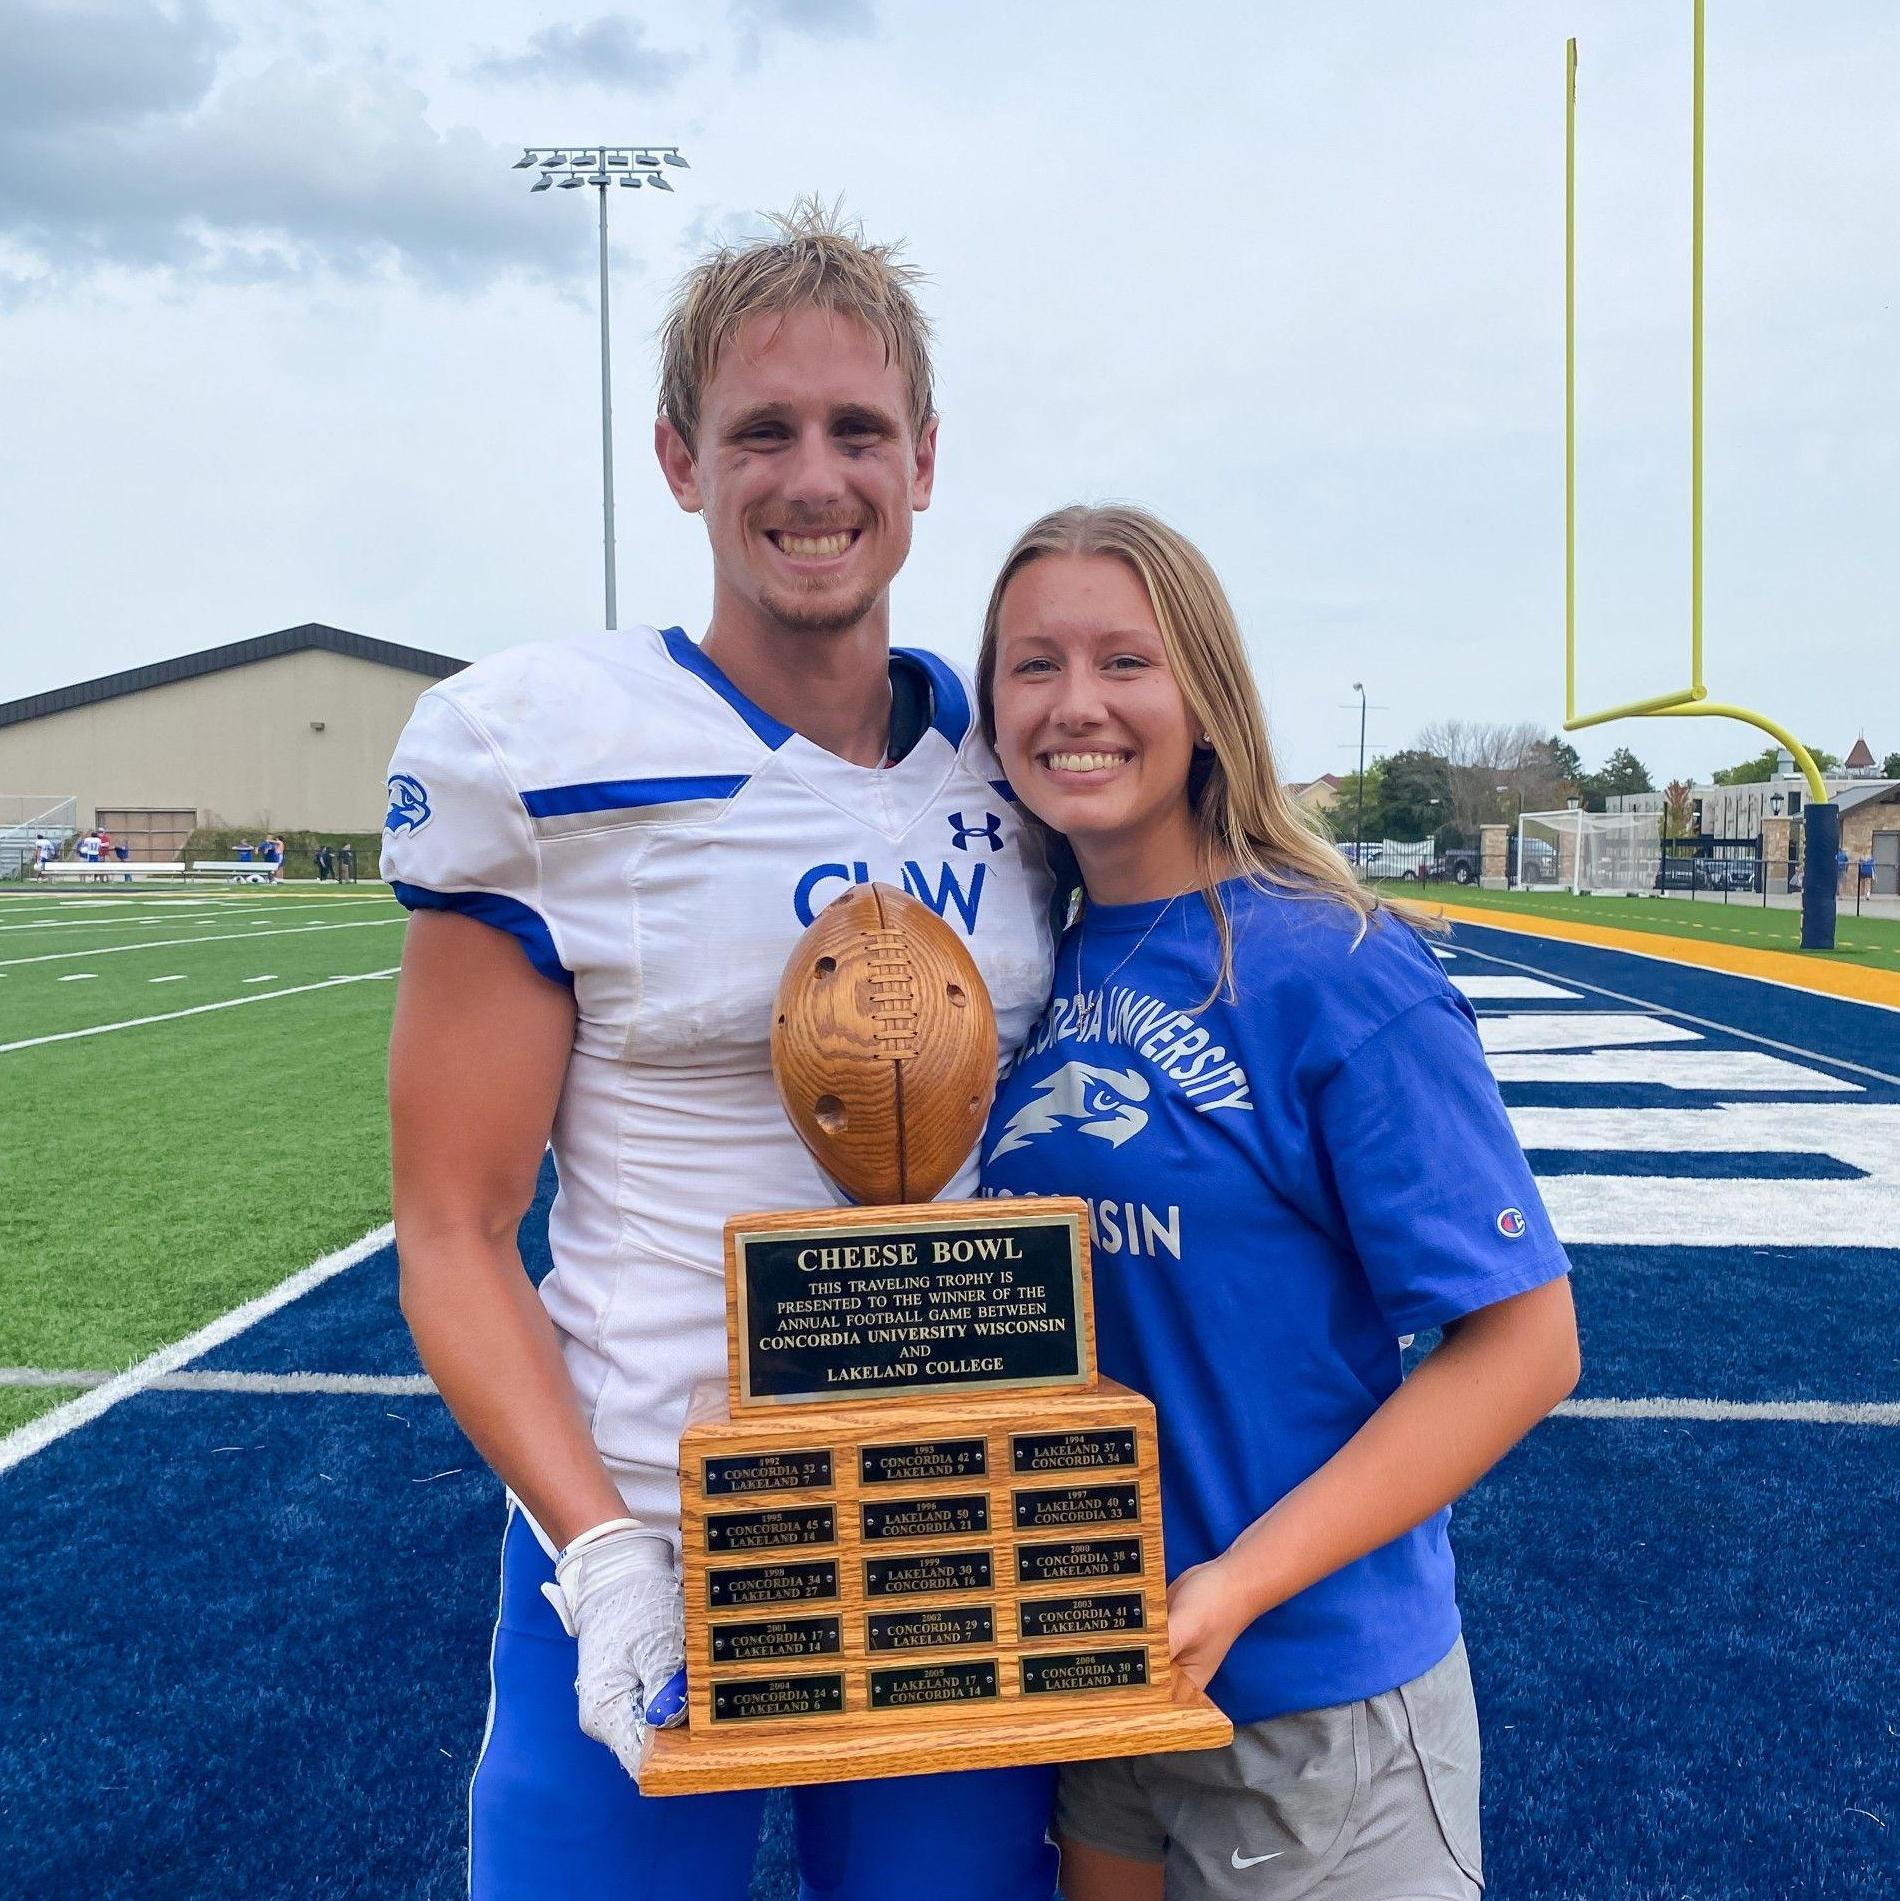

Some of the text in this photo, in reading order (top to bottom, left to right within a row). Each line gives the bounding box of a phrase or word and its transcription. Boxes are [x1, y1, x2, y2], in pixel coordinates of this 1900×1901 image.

[794, 861, 985, 935] CW
[1107, 986, 1253, 1113] UNIVERSITY
[798, 1238, 1022, 1272] CHEESE BOWL
[809, 1272, 1013, 1295] THIS TRAVELING TROPHY IS
[778, 1286, 1045, 1315] PRESENTED TO THE WINNER OF THE
[777, 1303, 1047, 1332] ANNUAL FOOTBALL GAME BETWEEN
[759, 1319, 1065, 1351] CONCORDIA UNIVERSITY WISCONSIN
[900, 1346, 931, 1359] AND
[827, 1358, 1003, 1382] LAKELAND COLLEGE
[1066, 1436, 1084, 1444] 1994
[915, 1446, 934, 1454] 1993
[1034, 1443, 1115, 1457] LAKELAND 37
[880, 1453, 969, 1468] CONCORDIA 42
[1032, 1454, 1119, 1468] CONCORDIA 34
[724, 1466, 798, 1480] CONCORDIA
[888, 1464, 964, 1478] LAKELAND 9
[732, 1476, 810, 1491] LAKELAND 7
[1068, 1491, 1087, 1499] 1997
[917, 1503, 936, 1511] 1996
[1037, 1498, 1118, 1512] LAKELAND 40
[886, 1511, 951, 1524] LAKELAND
[1035, 1509, 1122, 1524] CONCORDIA 33
[726, 1520, 818, 1536] CONCORDIA 45
[882, 1521, 972, 1536] CONCORDIA 21
[730, 1532, 815, 1547] LAKELAND 14
[920, 1558, 940, 1567] 1999
[1037, 1552, 1125, 1567] CONCORDIA 38
[889, 1566, 954, 1580] LAKELAND
[1043, 1563, 1119, 1578] LAKELAND 0
[729, 1577, 803, 1591] CONCORDIA
[886, 1576, 976, 1592] CONCORDIA 16
[733, 1587, 817, 1602] LAKELAND 27
[1073, 1600, 1092, 1609] 2003
[1039, 1606, 1127, 1622] CONCORDIA 41
[888, 1620, 977, 1636] CONCORDIA 29
[1043, 1618, 1125, 1634] LAKELAND 20
[732, 1631, 823, 1646] CONCORDIA 17
[894, 1632, 972, 1647] LAKELAND 7
[736, 1642, 820, 1657] LAKELAND 14
[1042, 1664, 1114, 1679] CONCORDIA
[769, 1682, 790, 1690] 2004
[894, 1676, 976, 1692] LAKELAND 17
[1046, 1676, 1111, 1690] LAKELAND
[734, 1688, 825, 1704] CONCORDIA 24
[890, 1686, 980, 1703] CONCORDIA 14
[741, 1702, 808, 1715] LAKELAND
